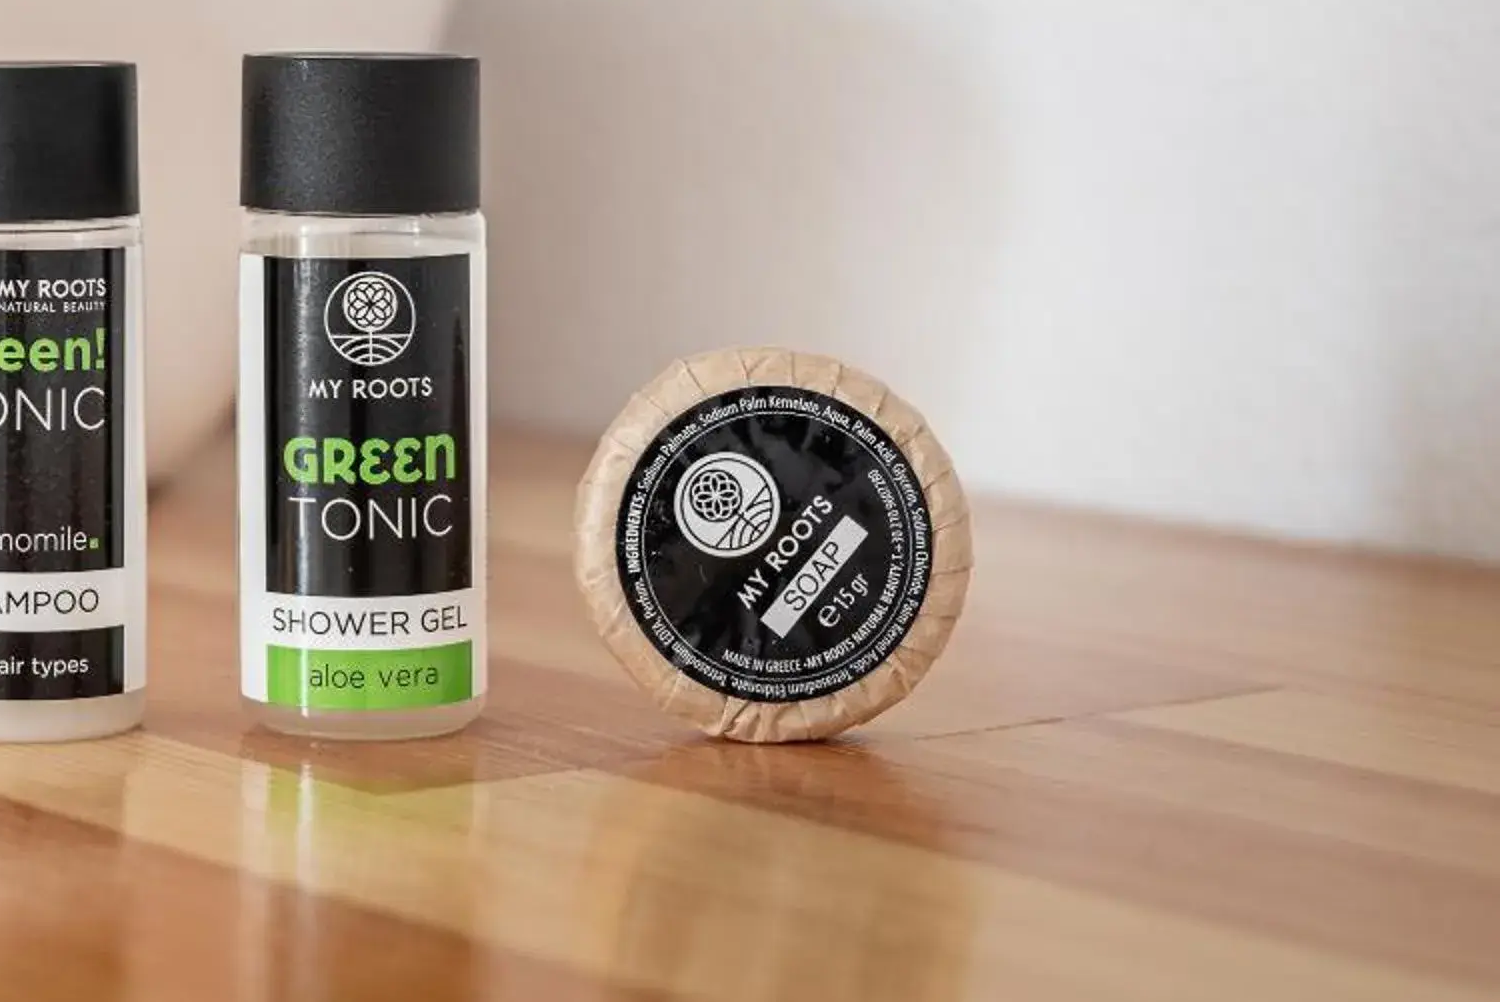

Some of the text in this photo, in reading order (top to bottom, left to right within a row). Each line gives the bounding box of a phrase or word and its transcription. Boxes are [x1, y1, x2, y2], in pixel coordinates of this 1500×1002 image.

[38, 278, 107, 298] ROOTS
[63, 300, 106, 312] BEAUTY
[308, 377, 433, 399] MY ROOTS
[289, 494, 452, 541] TONIC
[737, 496, 833, 610] MY ROOTS
[784, 542, 838, 610] SOAP
[273, 605, 468, 636] SHOWER GEL
[31, 657, 89, 678] types
[309, 663, 439, 689] aloe vera
